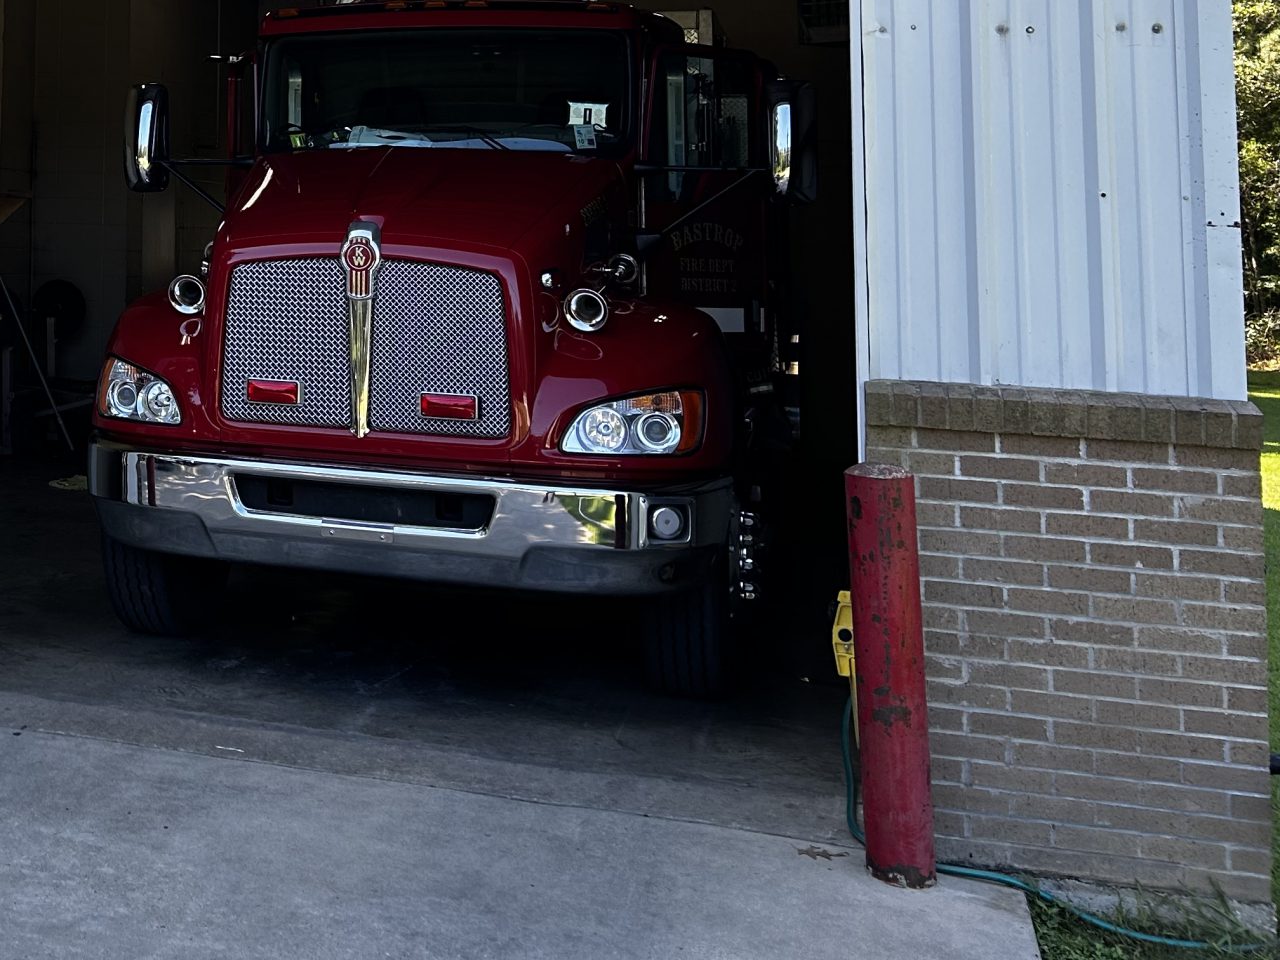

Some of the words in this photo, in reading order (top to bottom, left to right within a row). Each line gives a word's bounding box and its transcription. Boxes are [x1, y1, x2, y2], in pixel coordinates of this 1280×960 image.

[671, 222, 744, 253] BASTROP
[680, 257, 705, 273] FIRE
[680, 277, 729, 293] DISTRICT
